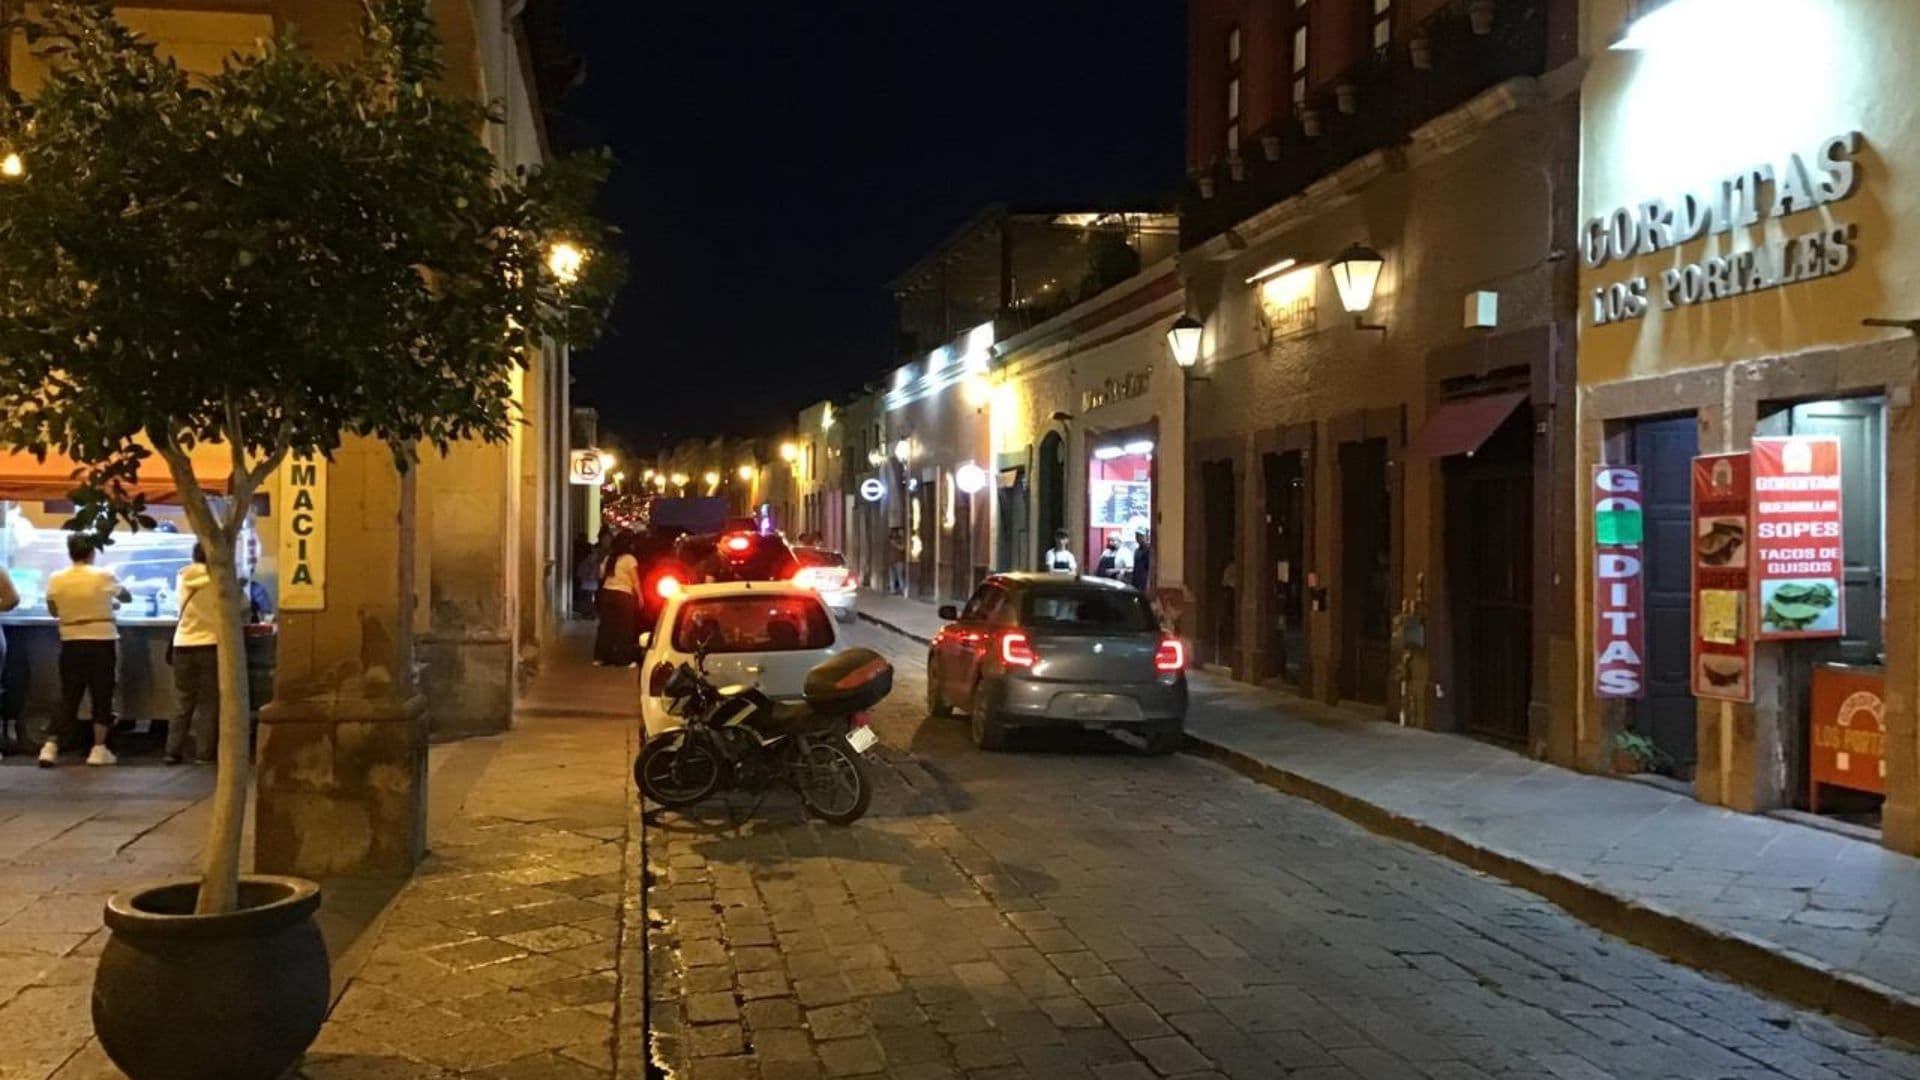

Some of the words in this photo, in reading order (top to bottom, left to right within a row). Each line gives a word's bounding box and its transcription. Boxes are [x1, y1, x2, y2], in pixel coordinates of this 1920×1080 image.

[1581, 130, 1865, 268] GORDITAS
[1660, 223, 1858, 311] PORTALES
[1758, 521, 1840, 538] SOPES
[1759, 548, 1816, 560] TACOS
[1819, 547, 1840, 560] DE
[1595, 468, 1642, 695] GODITAS
[1767, 561, 1832, 574] GUISOS
